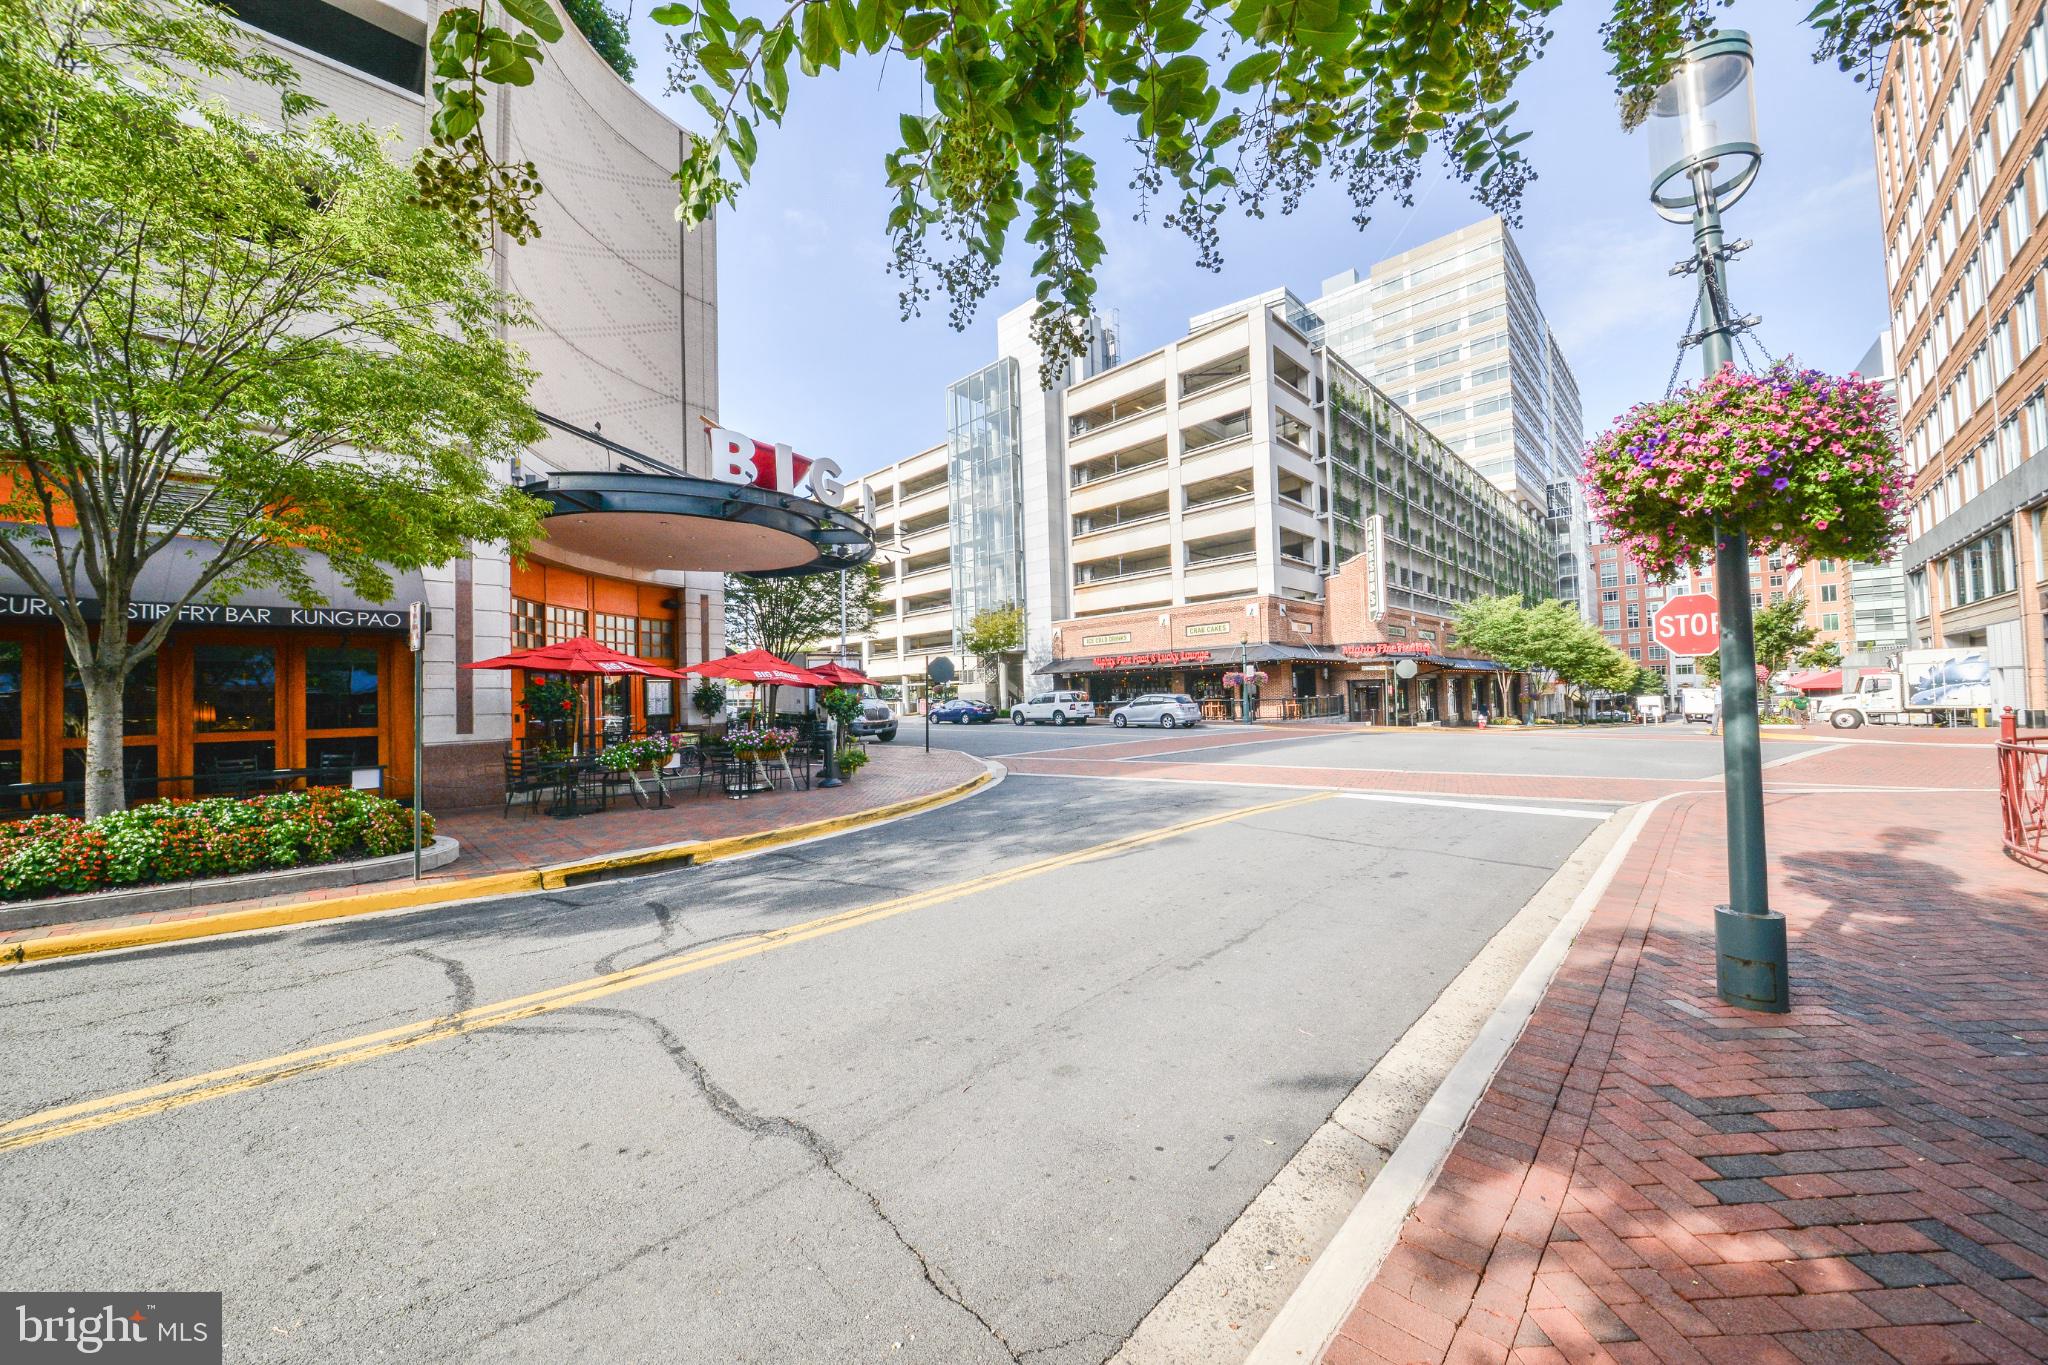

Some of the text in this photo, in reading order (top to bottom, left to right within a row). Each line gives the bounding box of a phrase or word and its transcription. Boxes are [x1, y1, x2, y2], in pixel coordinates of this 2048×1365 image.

[710, 427, 845, 506] BIG
[0, 596, 401, 628] CURY STIR FRY BAR KUNG PAO
[1206, 624, 1227, 633] CAKES
